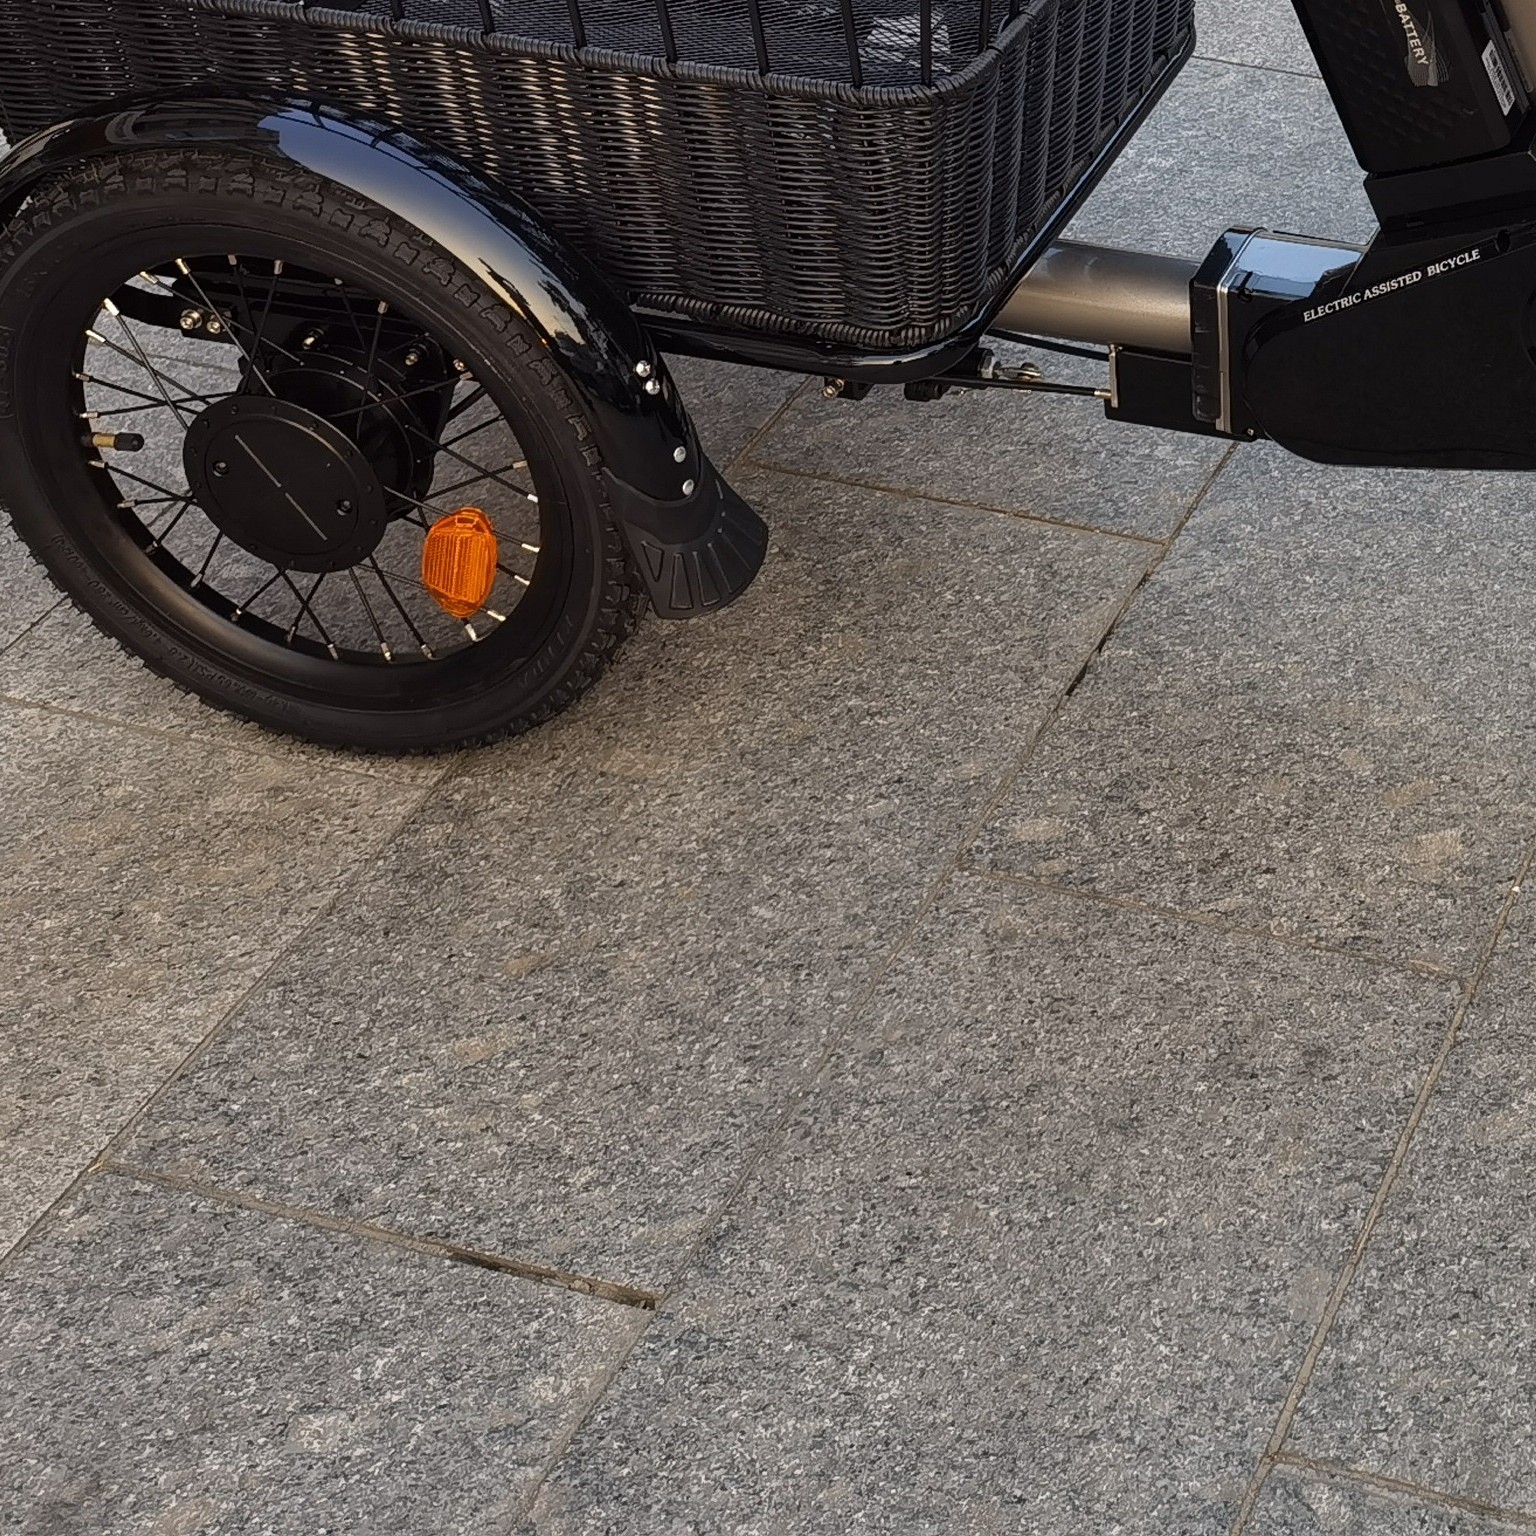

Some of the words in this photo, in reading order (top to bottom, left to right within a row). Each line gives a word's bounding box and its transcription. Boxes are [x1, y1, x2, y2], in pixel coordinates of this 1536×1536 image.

[1395, 3, 1430, 65] BATTERY
[1303, 292, 1362, 323] ELECTRIC
[1363, 270, 1423, 301] ASSISTED
[1427, 248, 1481, 277] BICYCLE
